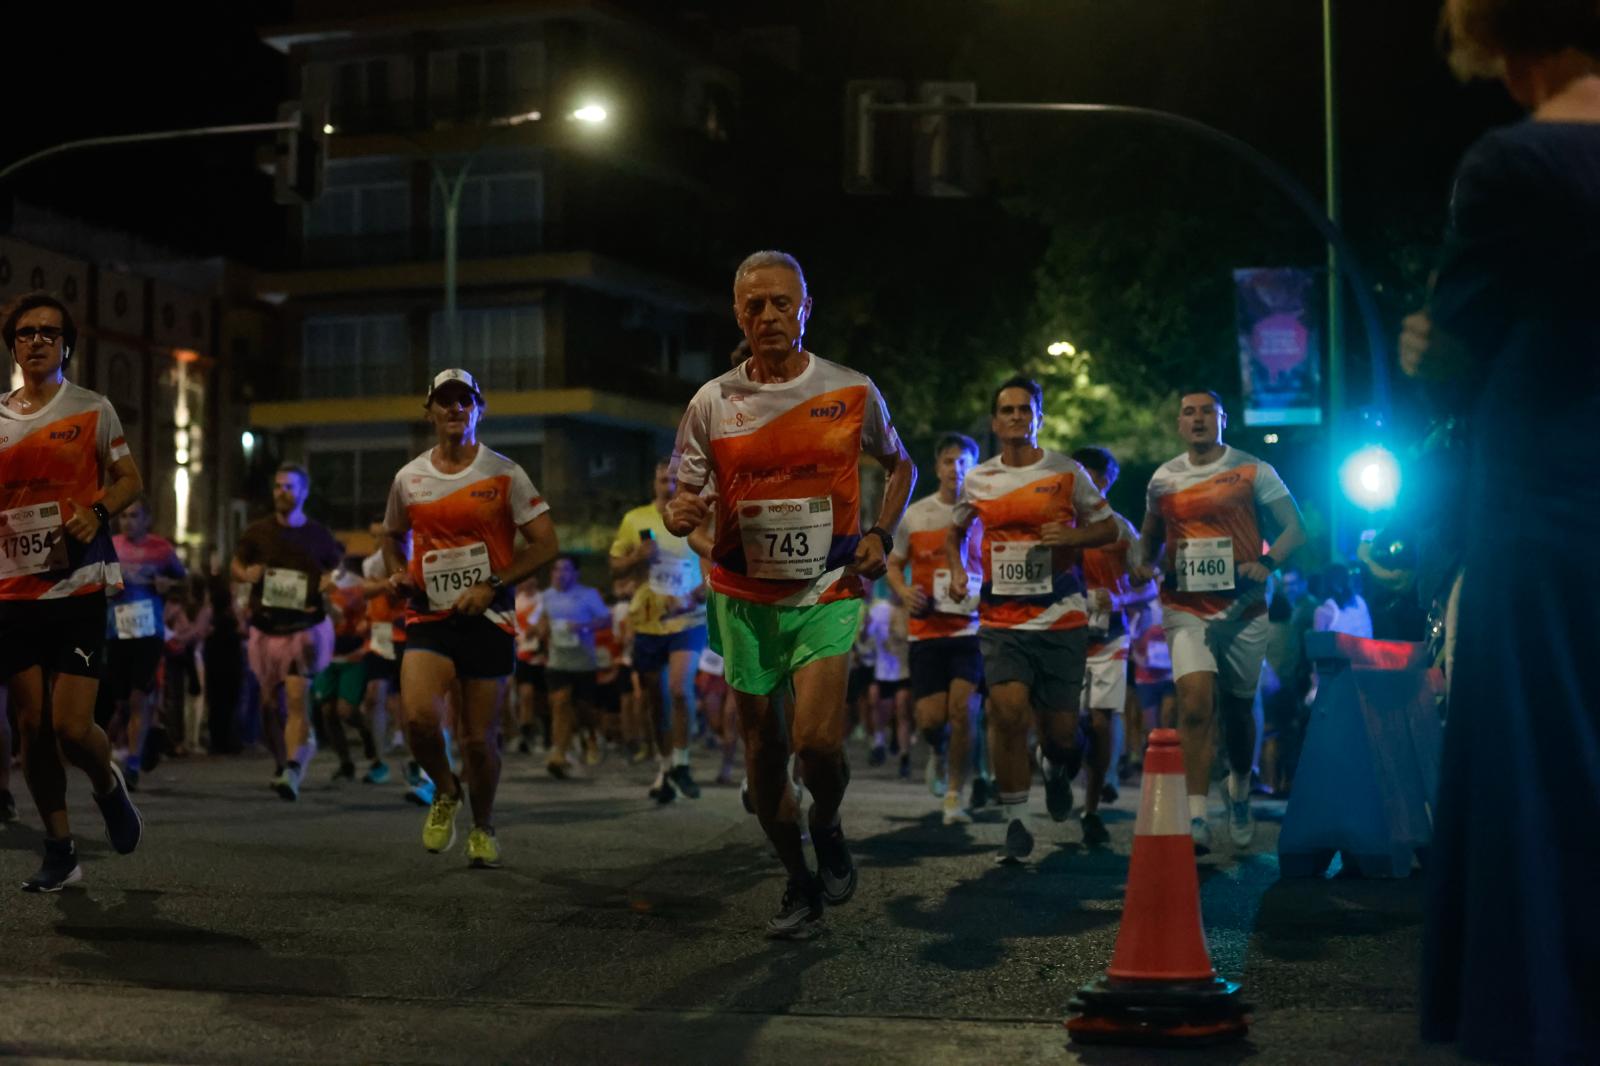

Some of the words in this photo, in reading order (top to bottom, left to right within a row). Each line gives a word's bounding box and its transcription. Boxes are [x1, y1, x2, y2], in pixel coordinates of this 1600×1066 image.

[811, 404, 840, 418] KH7
[2, 531, 55, 558] 17954
[765, 532, 809, 557] 743
[999, 563, 1043, 580] 10987
[1181, 558, 1225, 576] 21460
[432, 568, 483, 593] 17952
